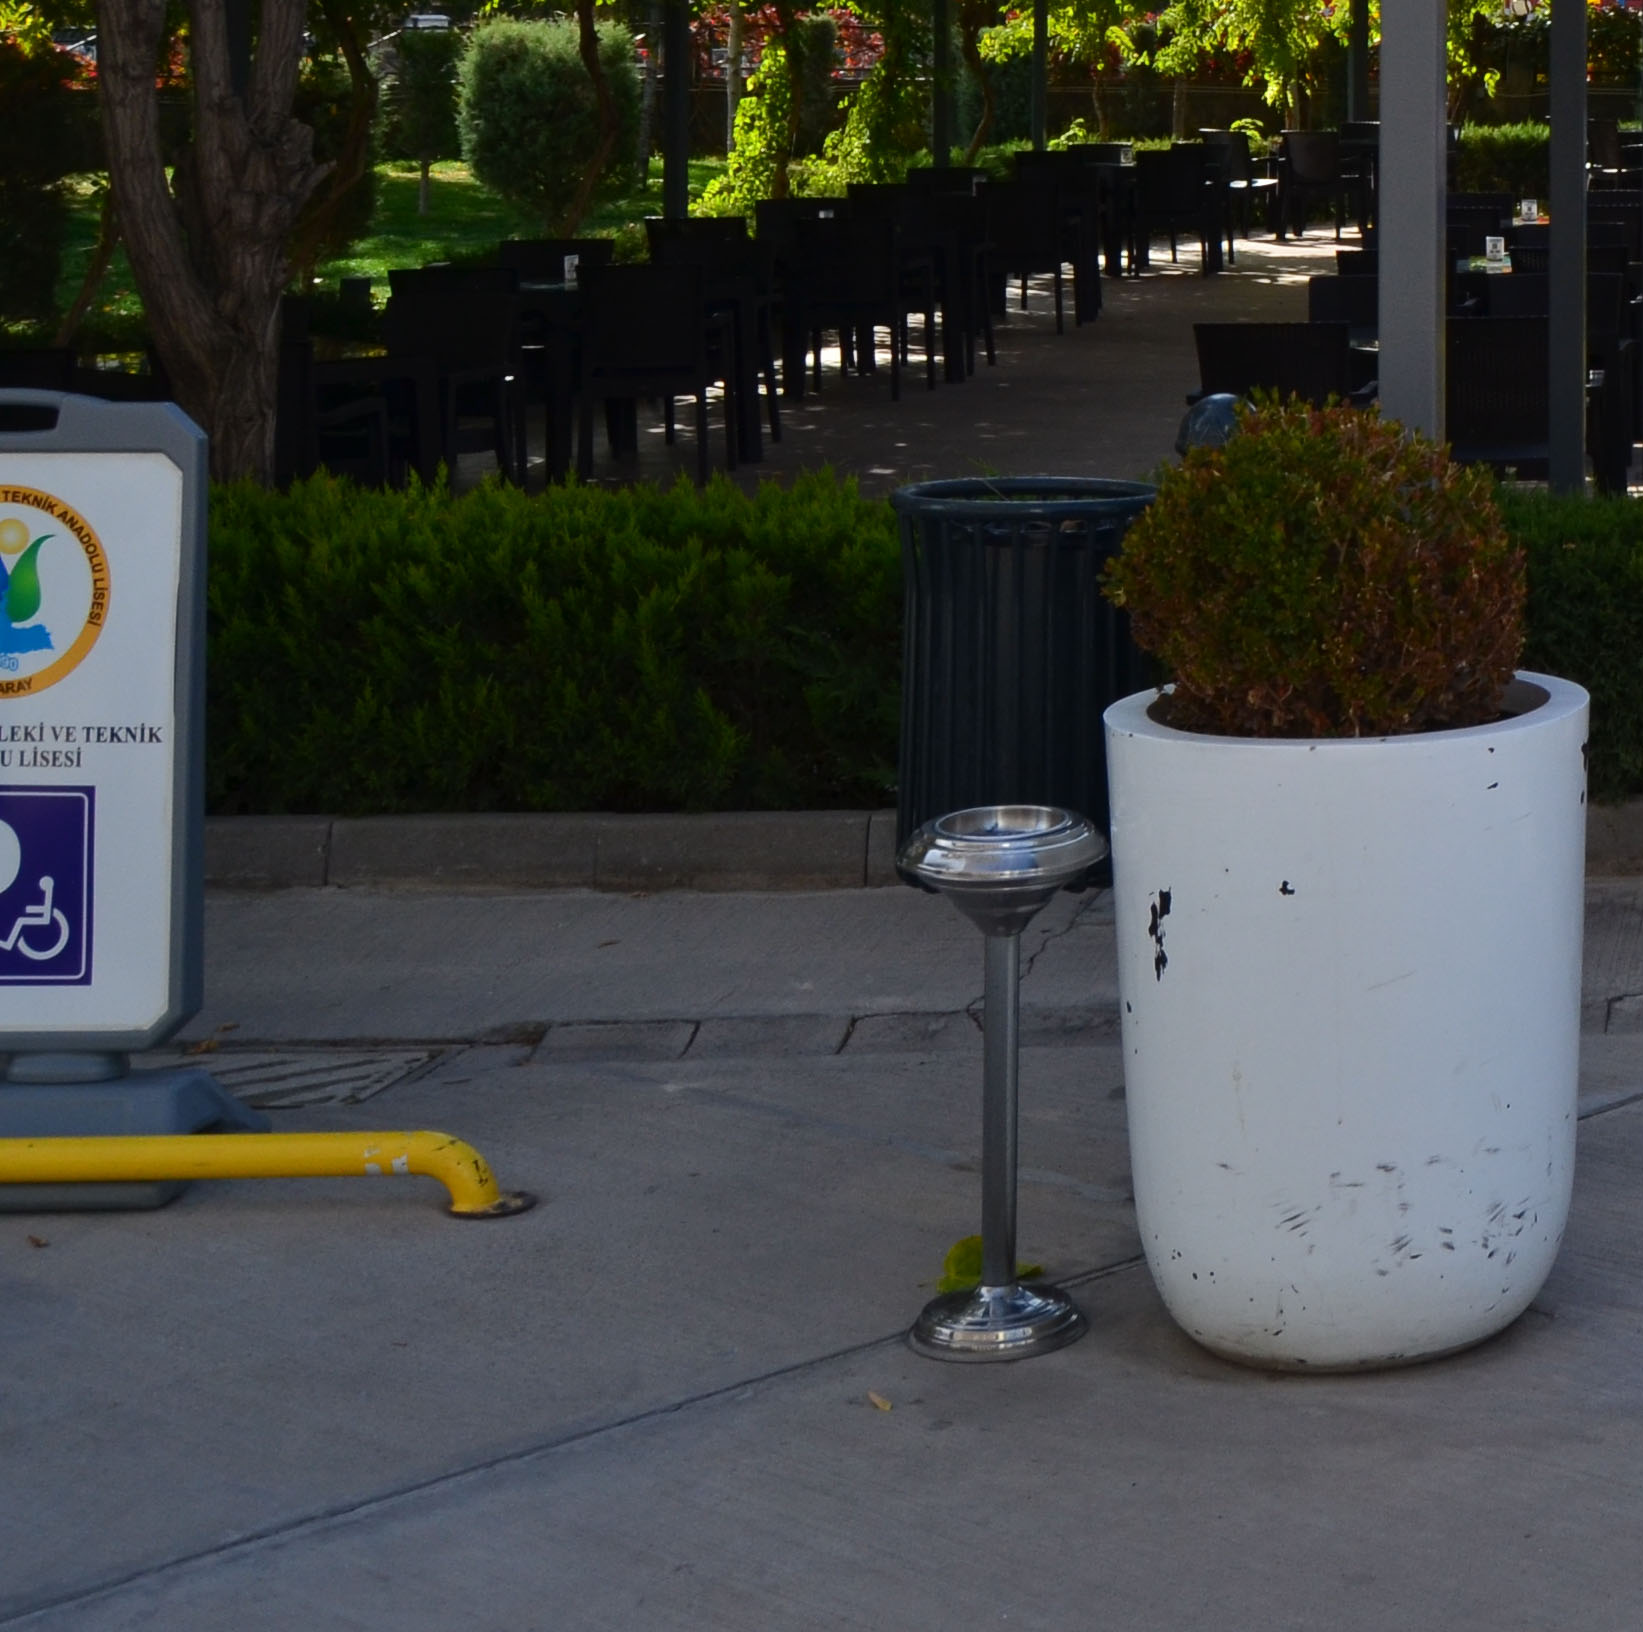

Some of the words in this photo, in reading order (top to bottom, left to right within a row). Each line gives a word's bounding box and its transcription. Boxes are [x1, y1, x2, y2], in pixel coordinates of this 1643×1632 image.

[2, 490, 56, 515] TEKNİK
[57, 510, 104, 573] ANADOLU
[87, 577, 108, 627] LİSESİ
[51, 726, 77, 743] VE
[82, 723, 163, 744] TEKNİK
[19, 747, 82, 768] LİSESİ
